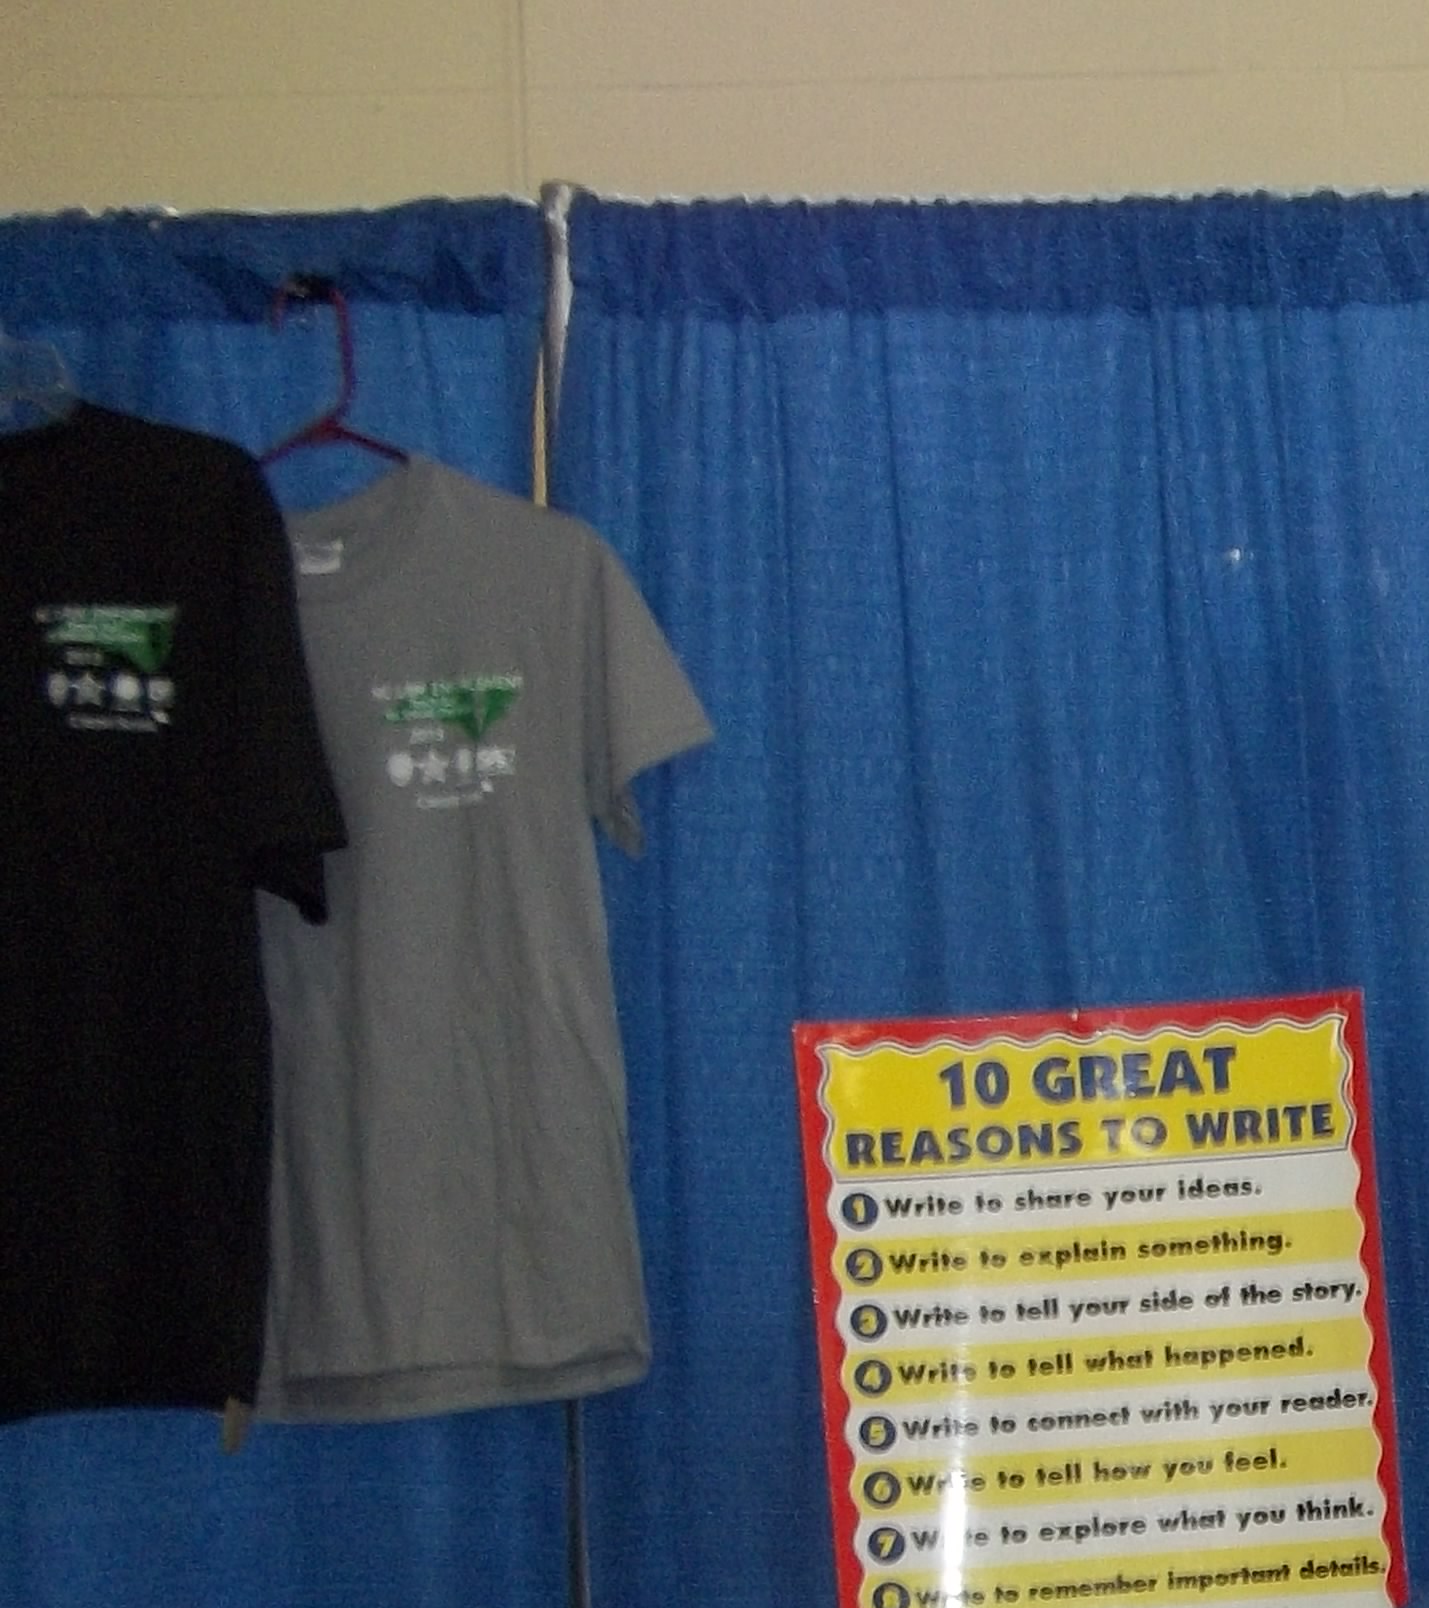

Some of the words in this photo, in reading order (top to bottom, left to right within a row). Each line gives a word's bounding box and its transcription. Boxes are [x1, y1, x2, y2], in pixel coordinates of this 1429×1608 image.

[939, 1059, 1009, 1110] 10
[1032, 1046, 1236, 1103] GREAT
[846, 1119, 1083, 1168] REASONS
[1102, 1115, 1168, 1150] TO
[1186, 1103, 1336, 1142] WRITE
[886, 1196, 963, 1217] Write
[976, 1196, 1002, 1213] to
[1015, 1189, 1092, 1211] share
[1105, 1188, 1166, 1210] your
[1179, 1179, 1262, 1200] ideas.
[890, 1251, 968, 1274] Write
[980, 1251, 1007, 1268] to
[1019, 1240, 1126, 1270] explain
[1138, 1230, 1292, 1256] something.
[895, 1306, 969, 1329] Write
[980, 1306, 1005, 1323] to
[1017, 1299, 1059, 1321] tell
[1069, 1299, 1129, 1323] your
[1140, 1290, 1193, 1312] side
[1205, 1287, 1230, 1308] of
[1240, 1285, 1282, 1304] the
[1293, 1282, 1362, 1303] story.
[899, 1362, 976, 1385] Write
[989, 1361, 1016, 1379] to
[1027, 1353, 1073, 1376] tell
[1085, 1350, 1154, 1373] what
[1165, 1336, 1314, 1368] happened.
[903, 1419, 979, 1440] Write
[991, 1417, 1016, 1435] to
[1027, 1407, 1129, 1432] connect
[1140, 1400, 1199, 1424] with
[1210, 1401, 1271, 1424] your
[1281, 1389, 1374, 1413] reader.
[907, 1473, 986, 1495] Wre
[997, 1472, 1024, 1489] to
[1036, 1463, 1081, 1486] tell
[1094, 1462, 1151, 1481] how
[1163, 1459, 1213, 1482] you
[1224, 1448, 1286, 1473] feel.
[912, 1527, 989, 1550] Wte
[1002, 1527, 1027, 1544] to
[1039, 1517, 1147, 1543] explore
[1158, 1511, 1226, 1532] what
[1236, 1508, 1285, 1531] you
[1296, 1497, 1374, 1522] think.
[917, 1590, 985, 1608] Wrte
[995, 1587, 1019, 1603] to
[1030, 1575, 1158, 1601] remember
[1167, 1565, 1290, 1592] important
[1299, 1556, 1386, 1580] details.
